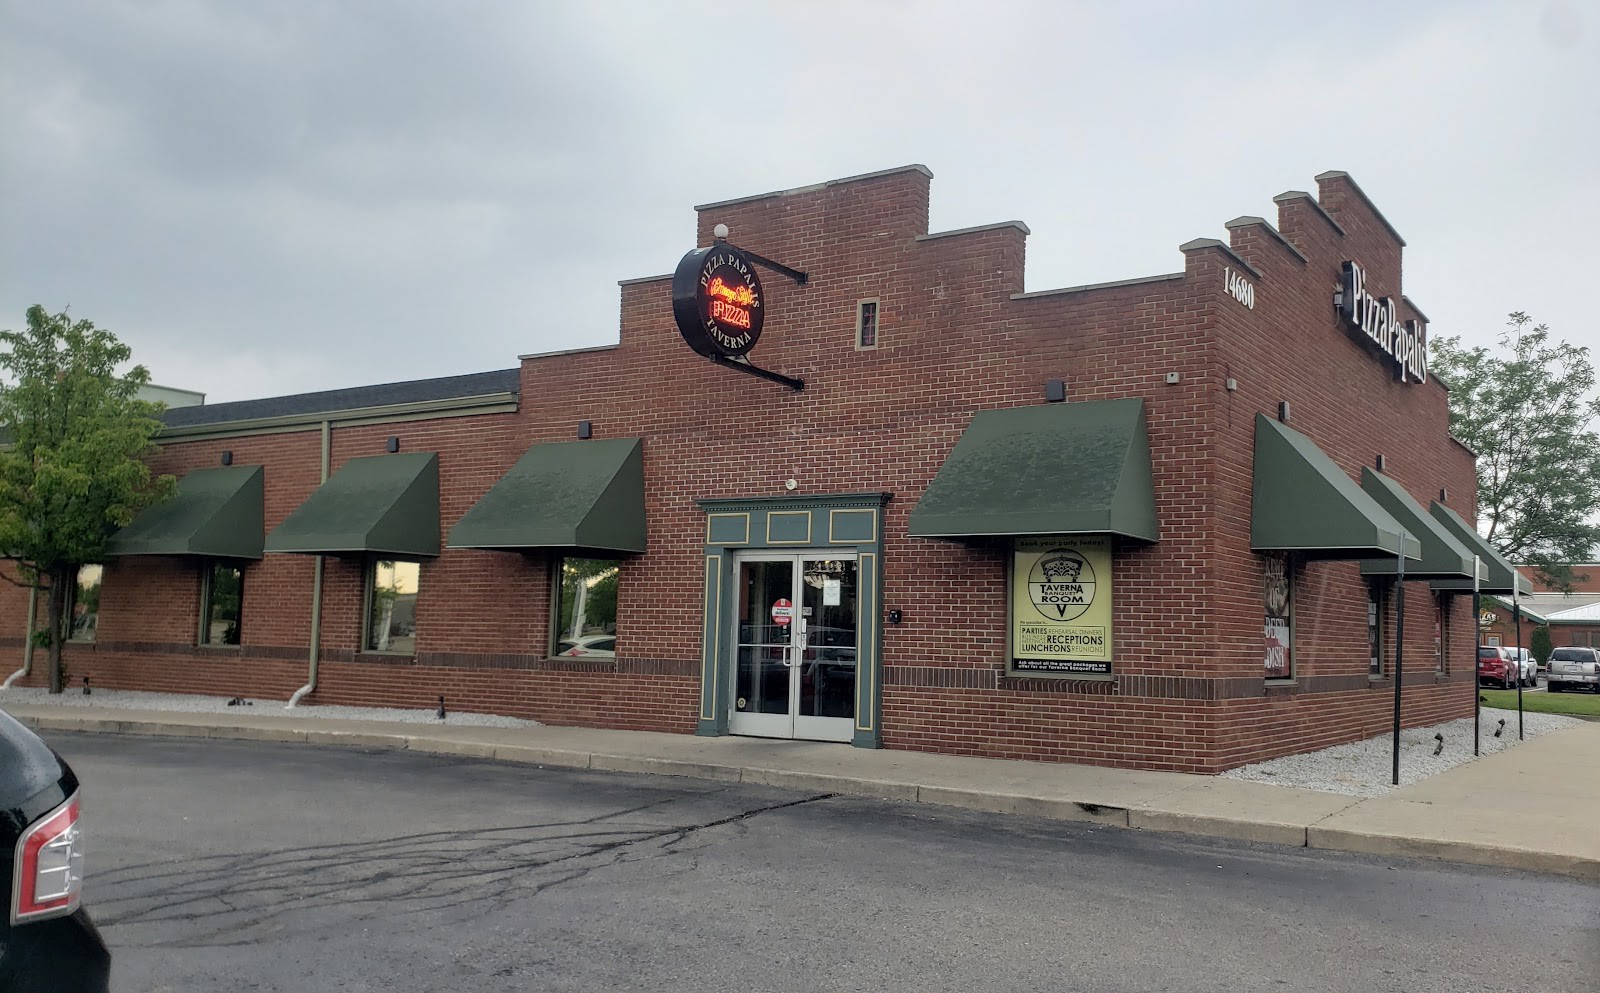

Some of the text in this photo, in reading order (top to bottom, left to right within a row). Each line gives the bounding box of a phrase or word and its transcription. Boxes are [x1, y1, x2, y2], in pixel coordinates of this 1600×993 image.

[701, 254, 760, 308] PIZZA PAPALIS
[1223, 266, 1255, 310] 14680
[706, 317, 751, 349] TAVERNA
[1040, 584, 1084, 594] TAVERNA
[1041, 595, 1084, 603] ROOM
[1021, 627, 1048, 635] PARTIES
[1047, 635, 1103, 645] RECEPTIONS
[1022, 644, 1071, 652] LUNCHEONS
[1266, 646, 1285, 669] DISH
